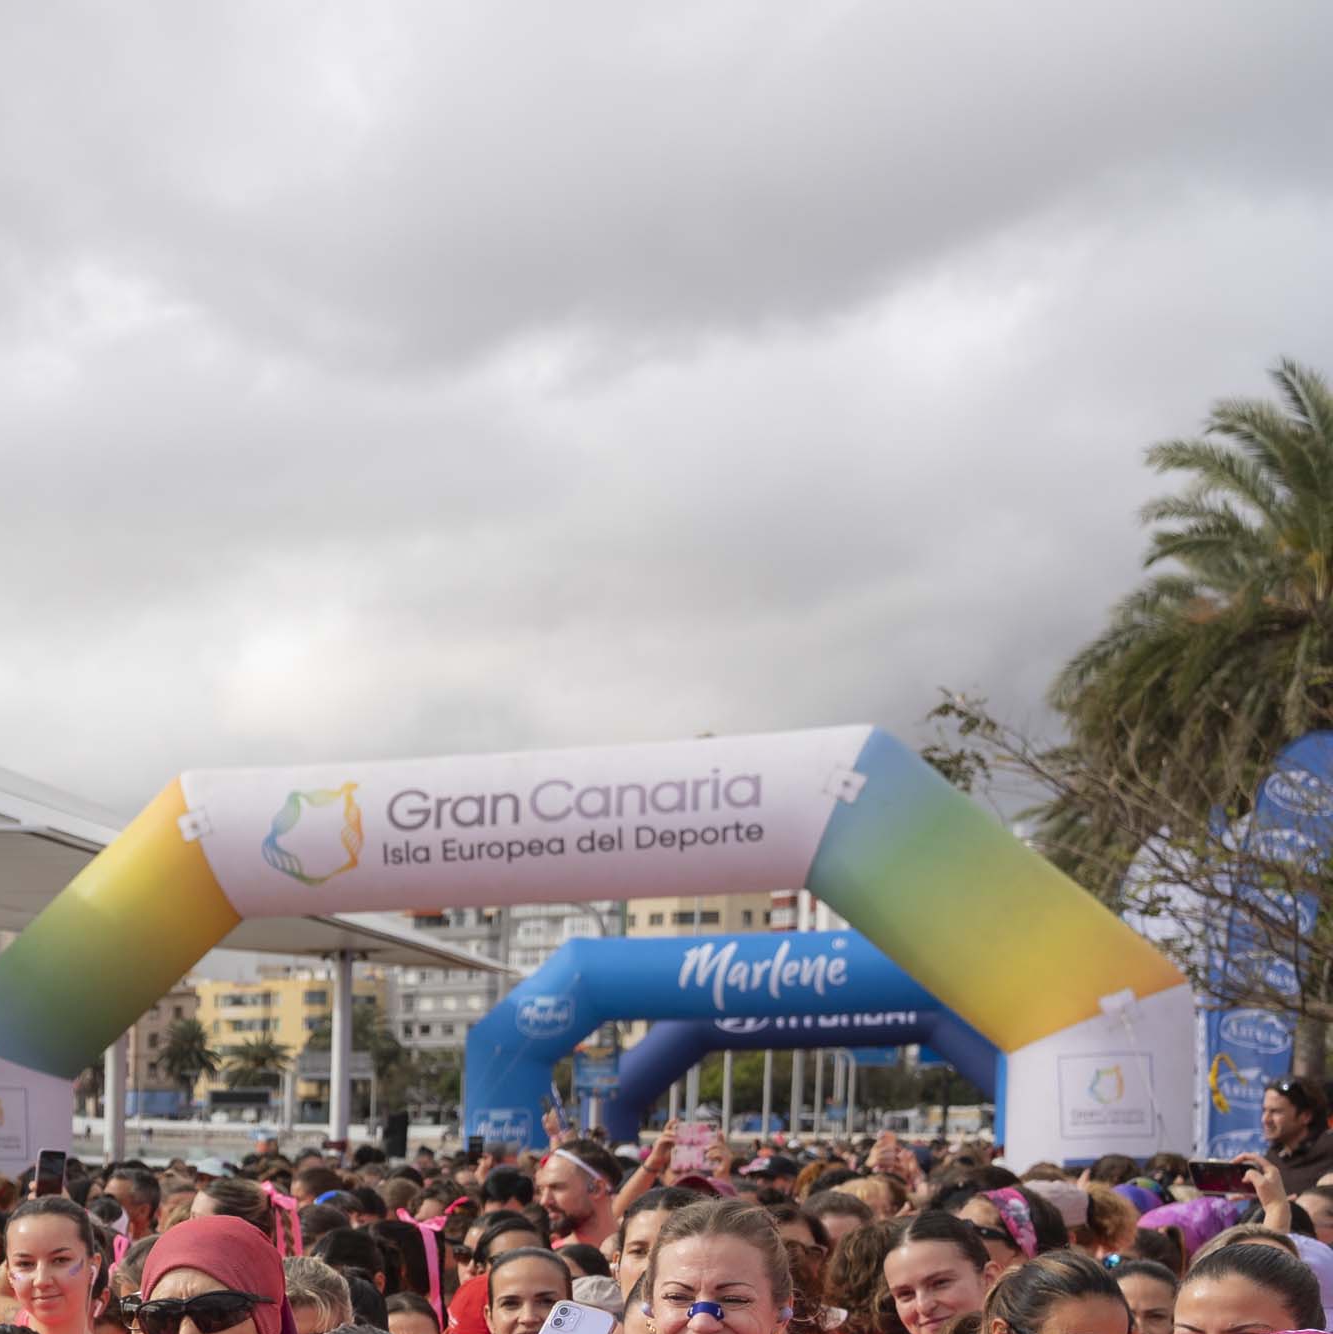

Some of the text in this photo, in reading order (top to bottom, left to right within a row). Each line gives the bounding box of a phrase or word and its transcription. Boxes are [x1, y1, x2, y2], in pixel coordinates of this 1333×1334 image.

[386, 768, 763, 832] Gran Canaria
[382, 820, 765, 868] Isla Europea del Deporte
[678, 940, 849, 1012] Marlene
